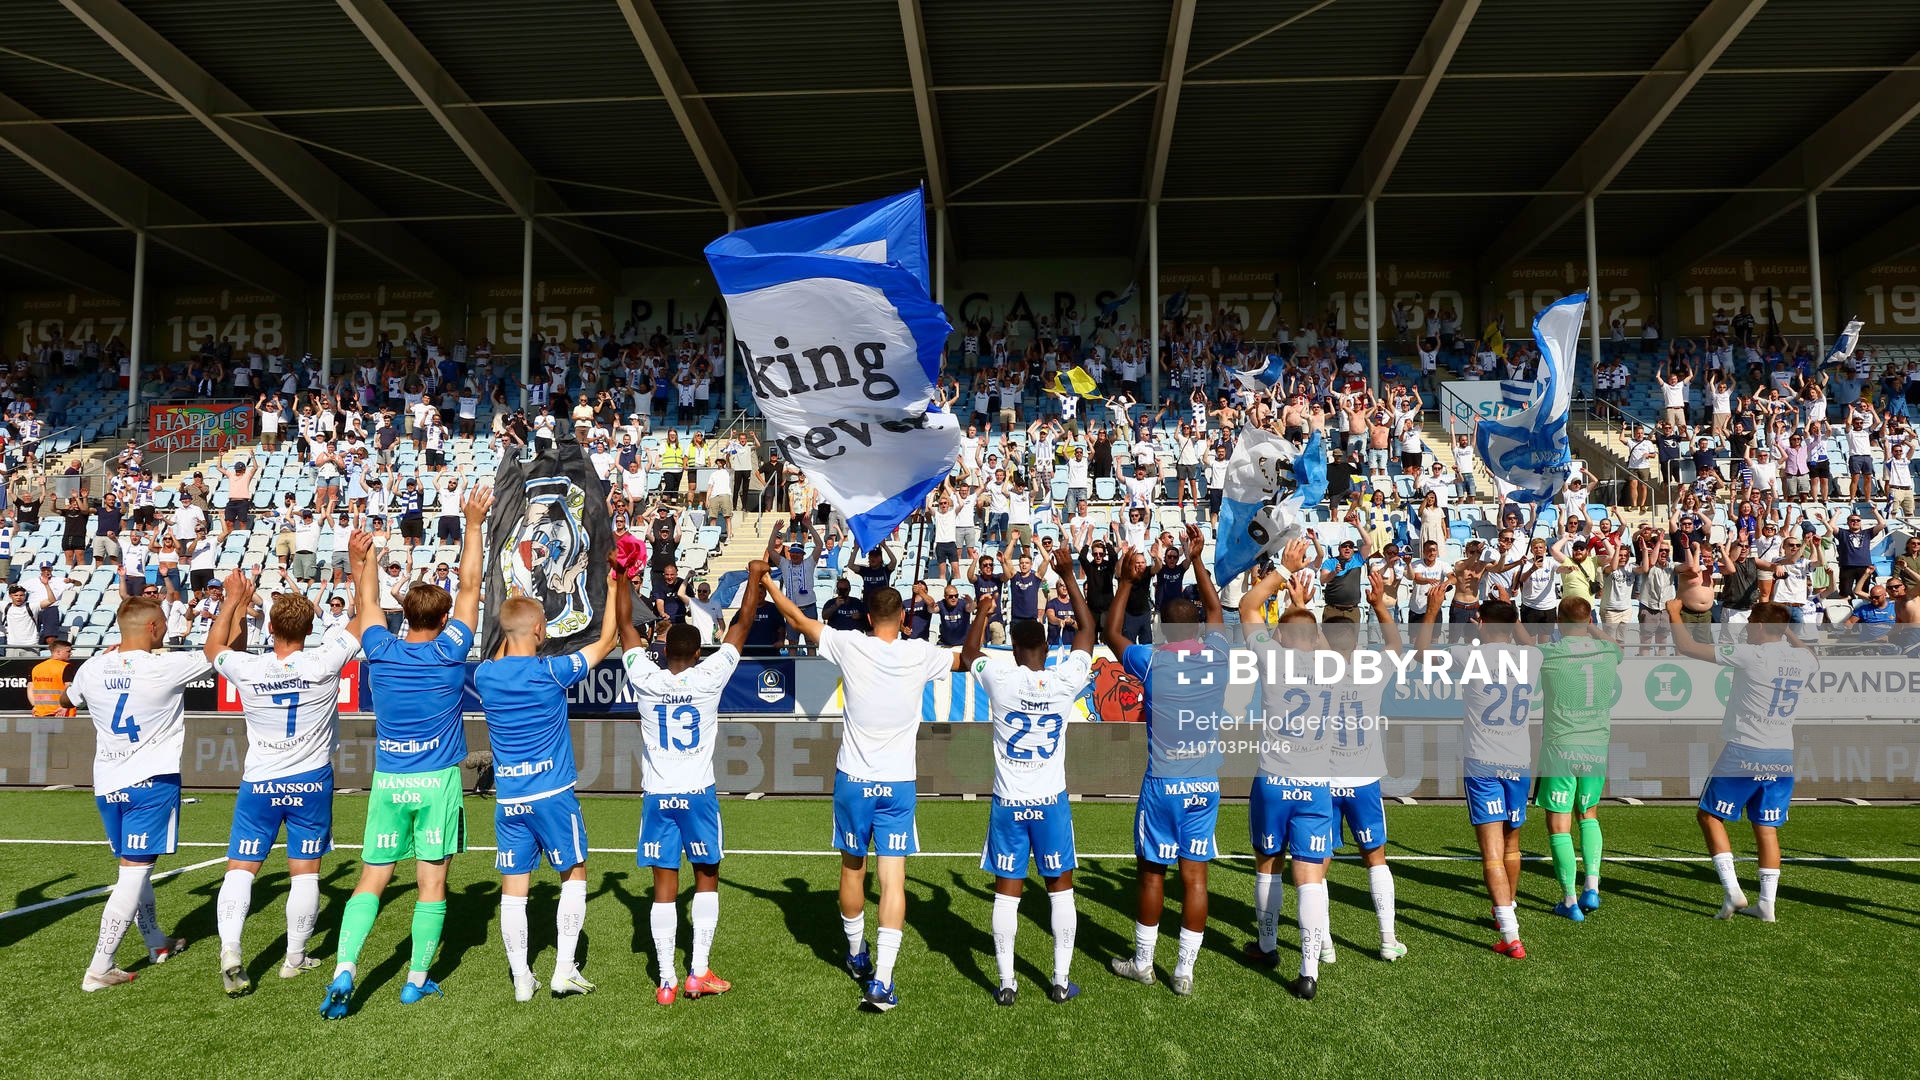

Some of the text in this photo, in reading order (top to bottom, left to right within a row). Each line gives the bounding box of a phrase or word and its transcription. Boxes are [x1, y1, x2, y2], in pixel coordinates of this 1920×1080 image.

[1512, 269, 1559, 279] SVENSKA
[1690, 266, 1737, 276] SVENSKA
[1684, 286, 1812, 325] 1963
[167, 314, 283, 352] 1948
[105, 678, 131, 690] LUND
[253, 679, 310, 695] FRANSSON
[1581, 663, 1594, 707] 1
[662, 694, 692, 704] ISHAQ
[1021, 699, 1049, 711] SEMA
[1481, 682, 1532, 726] 26
[1767, 678, 1803, 718] 15
[111, 693, 141, 743] 4
[272, 692, 299, 738] 7
[653, 705, 700, 751] 13
[1004, 711, 1062, 759] 23
[196, 728, 241, 772] PÅ
[379, 735, 439, 753] stadium
[496, 757, 553, 777] stadium
[1833, 746, 1871, 782] IN
[252, 780, 323, 794] MÅNSSON
[378, 775, 441, 789] MÅNSSON
[1165, 782, 1219, 795] MÅNSSON
[392, 791, 421, 804] RÖR
[863, 784, 892, 797] RÖR
[1282, 787, 1312, 801] RÖR
[106, 792, 130, 804] RÖR
[271, 795, 304, 806] RÖR
[659, 796, 689, 809] RÖR
[504, 803, 534, 816] RÖR
[1013, 808, 1043, 821] RÖR
